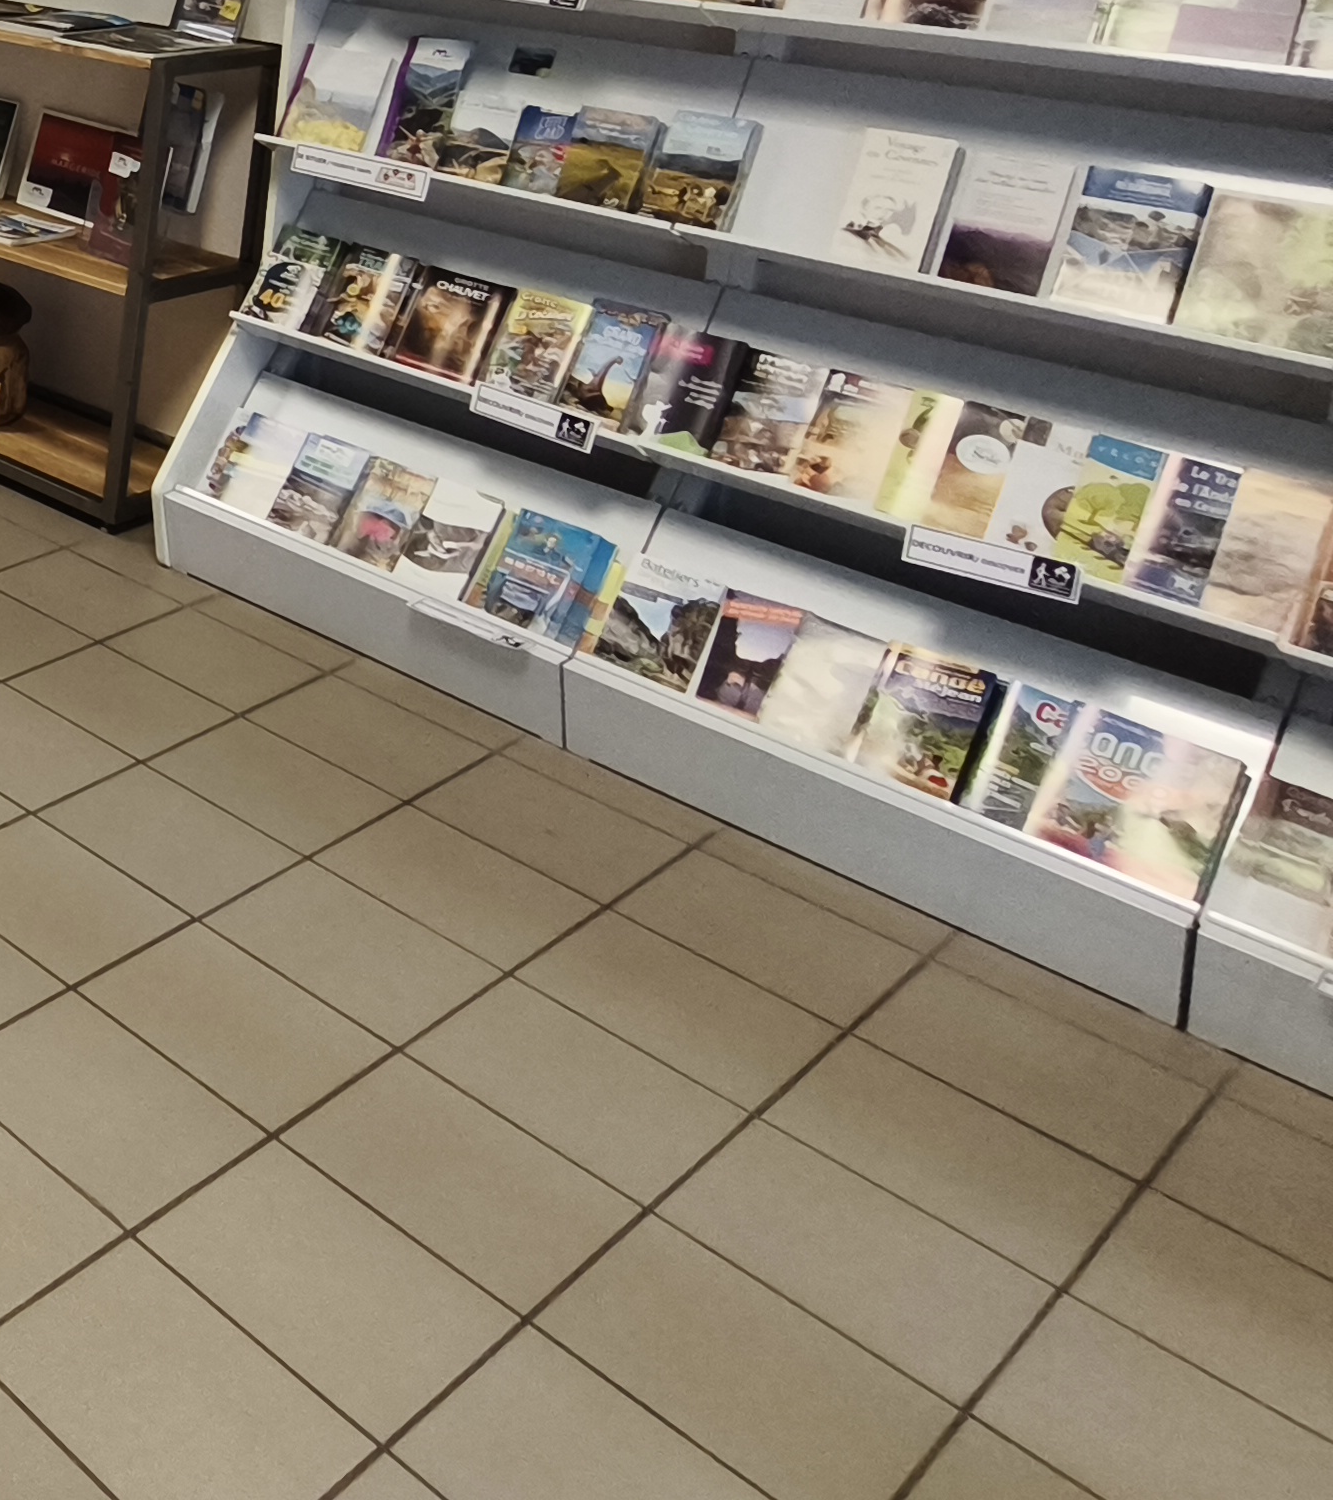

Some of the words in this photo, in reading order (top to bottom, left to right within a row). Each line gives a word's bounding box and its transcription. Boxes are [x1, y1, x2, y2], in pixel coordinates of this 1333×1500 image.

[436, 280, 492, 302] CHAUVET
[1214, 471, 1237, 488] Tra
[640, 558, 700, 588] Bateliers
